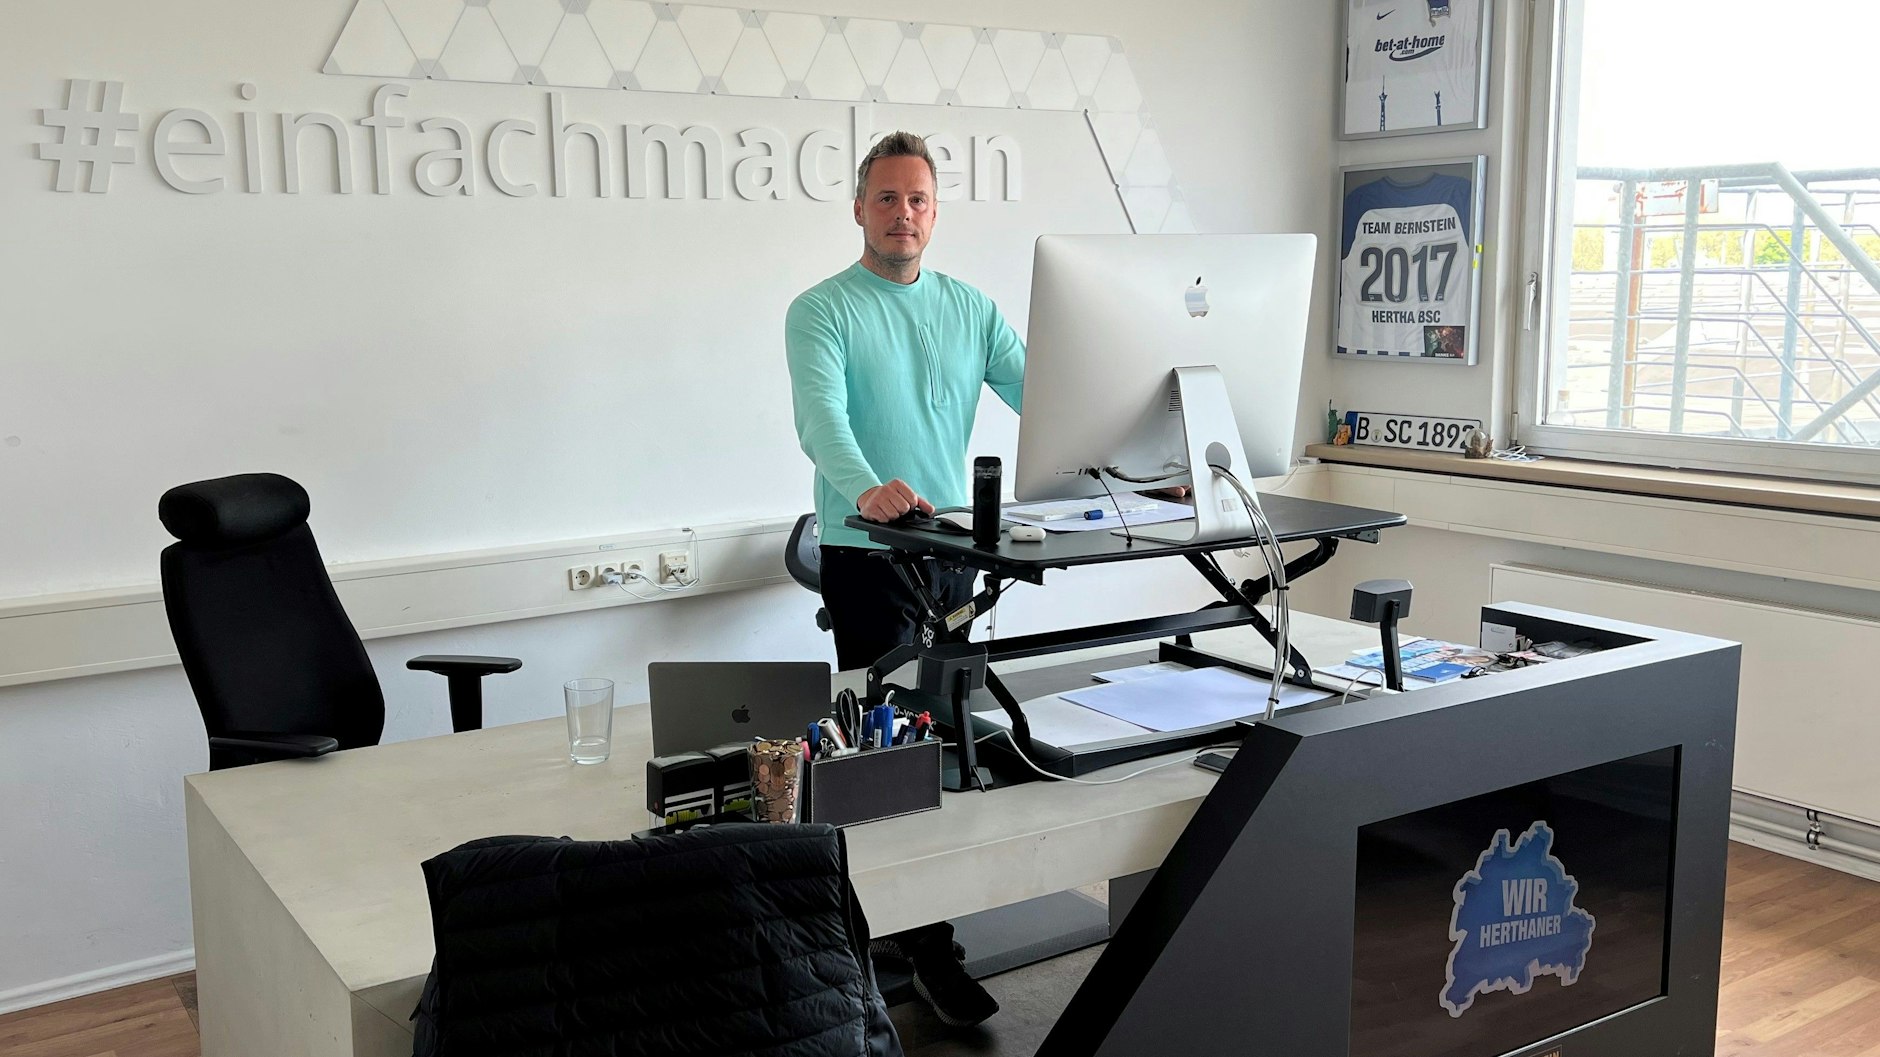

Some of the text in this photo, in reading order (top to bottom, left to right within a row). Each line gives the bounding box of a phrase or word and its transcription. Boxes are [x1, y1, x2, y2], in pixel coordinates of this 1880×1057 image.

[1374, 35, 1445, 52] bet-at-home
[1362, 217, 1456, 234] TEAM BERNSTEIN
[1361, 243, 1458, 302] 2017
[1372, 310, 1441, 323] HERTHA BSC
[1356, 416, 1370, 440] B
[1384, 419, 1412, 444] SC
[1501, 877, 1548, 916] WIR
[1479, 914, 1561, 948] HERTHANER
